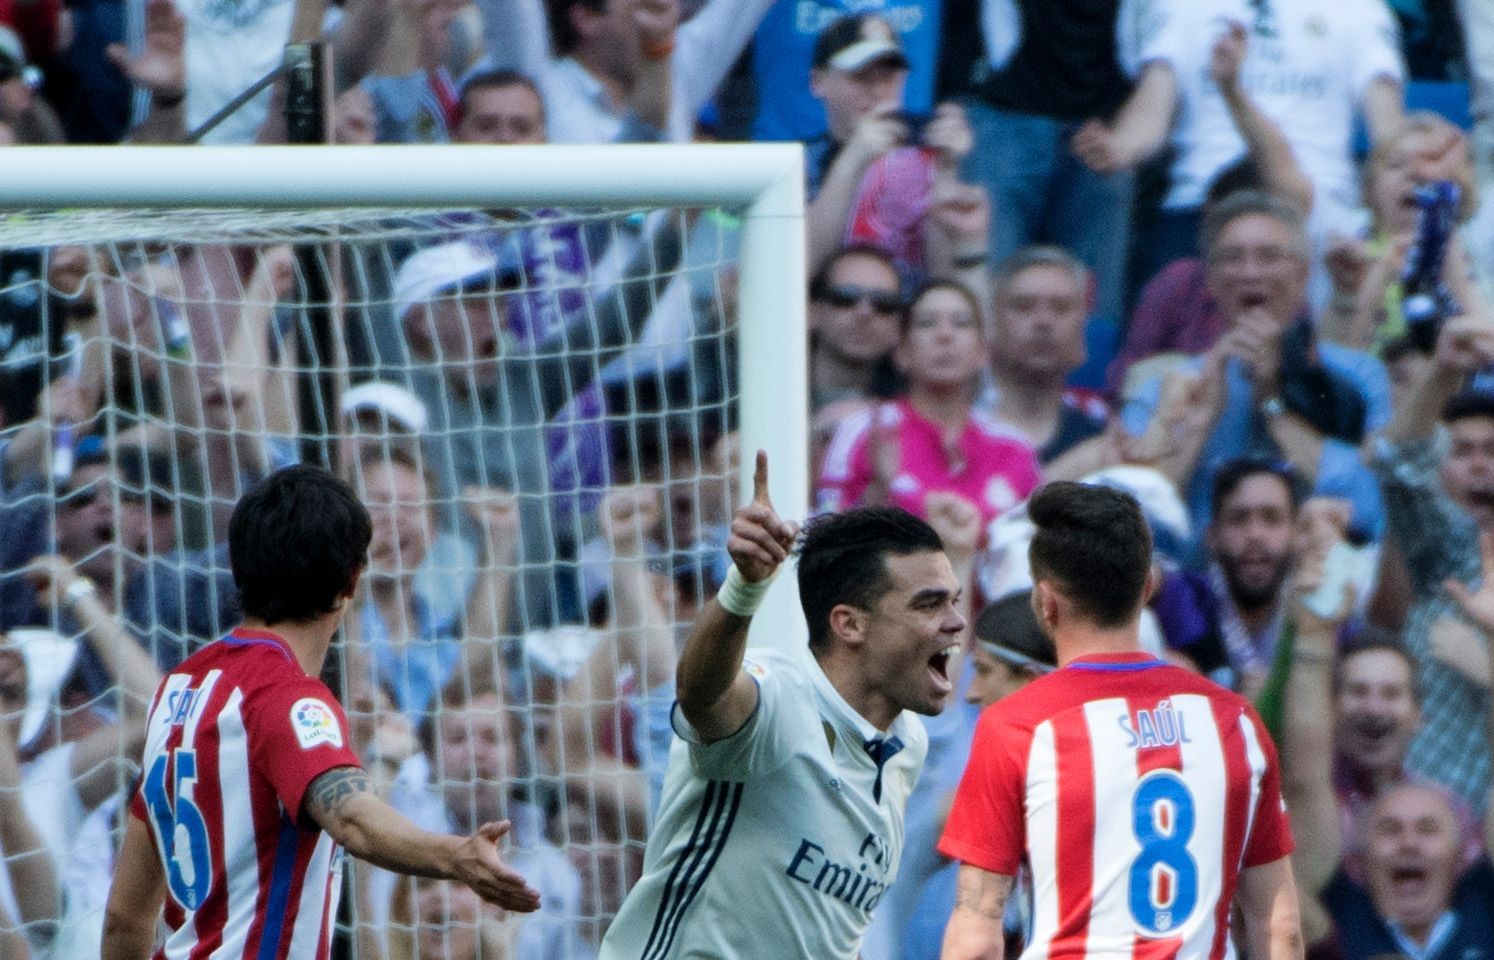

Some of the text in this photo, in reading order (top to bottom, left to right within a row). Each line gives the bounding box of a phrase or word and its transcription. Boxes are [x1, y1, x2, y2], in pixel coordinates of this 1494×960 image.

[1117, 700, 1192, 748] SAÚL
[140, 749, 213, 912] 15
[1129, 768, 1199, 937] 8
